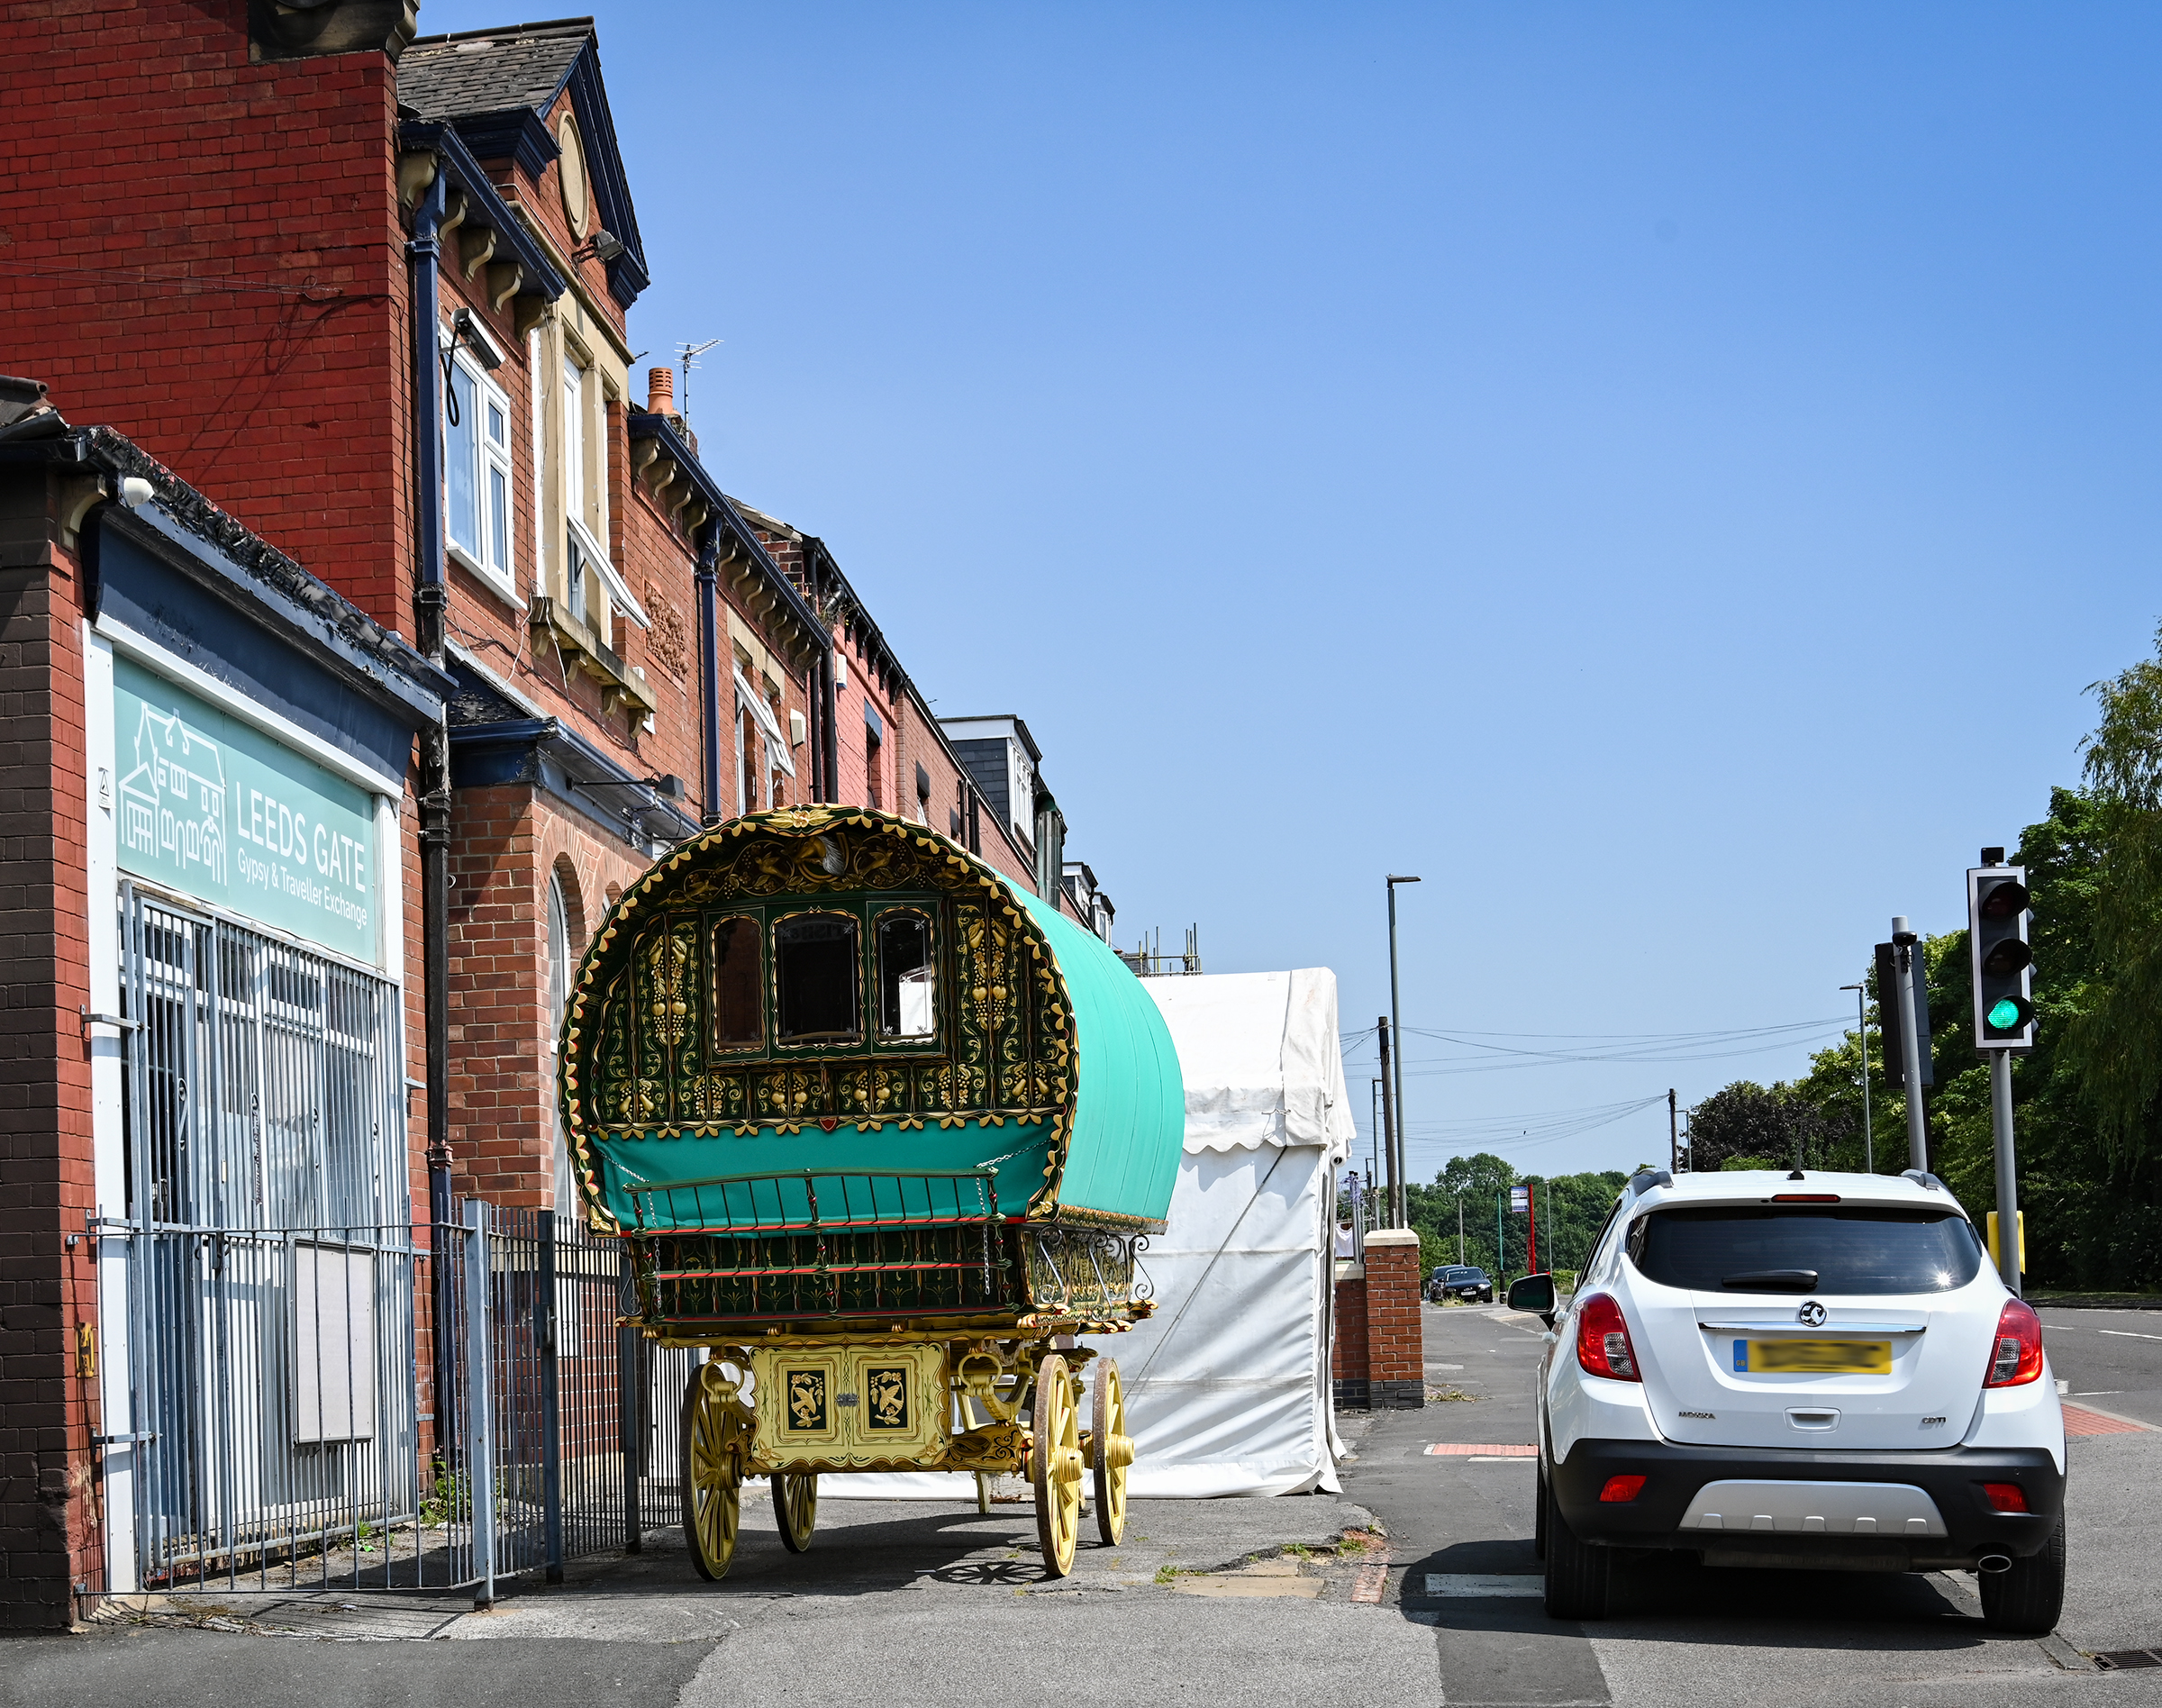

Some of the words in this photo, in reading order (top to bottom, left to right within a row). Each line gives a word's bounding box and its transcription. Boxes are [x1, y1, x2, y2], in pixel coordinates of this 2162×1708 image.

[236, 781, 307, 865] LEEDS
[313, 822, 366, 893] GATE
[238, 847, 269, 890] Gypsy
[271, 862, 279, 888] &
[280, 866, 322, 907] Traveller
[324, 886, 367, 930] Exchange
[1678, 1411, 1716, 1420] MOKKA
